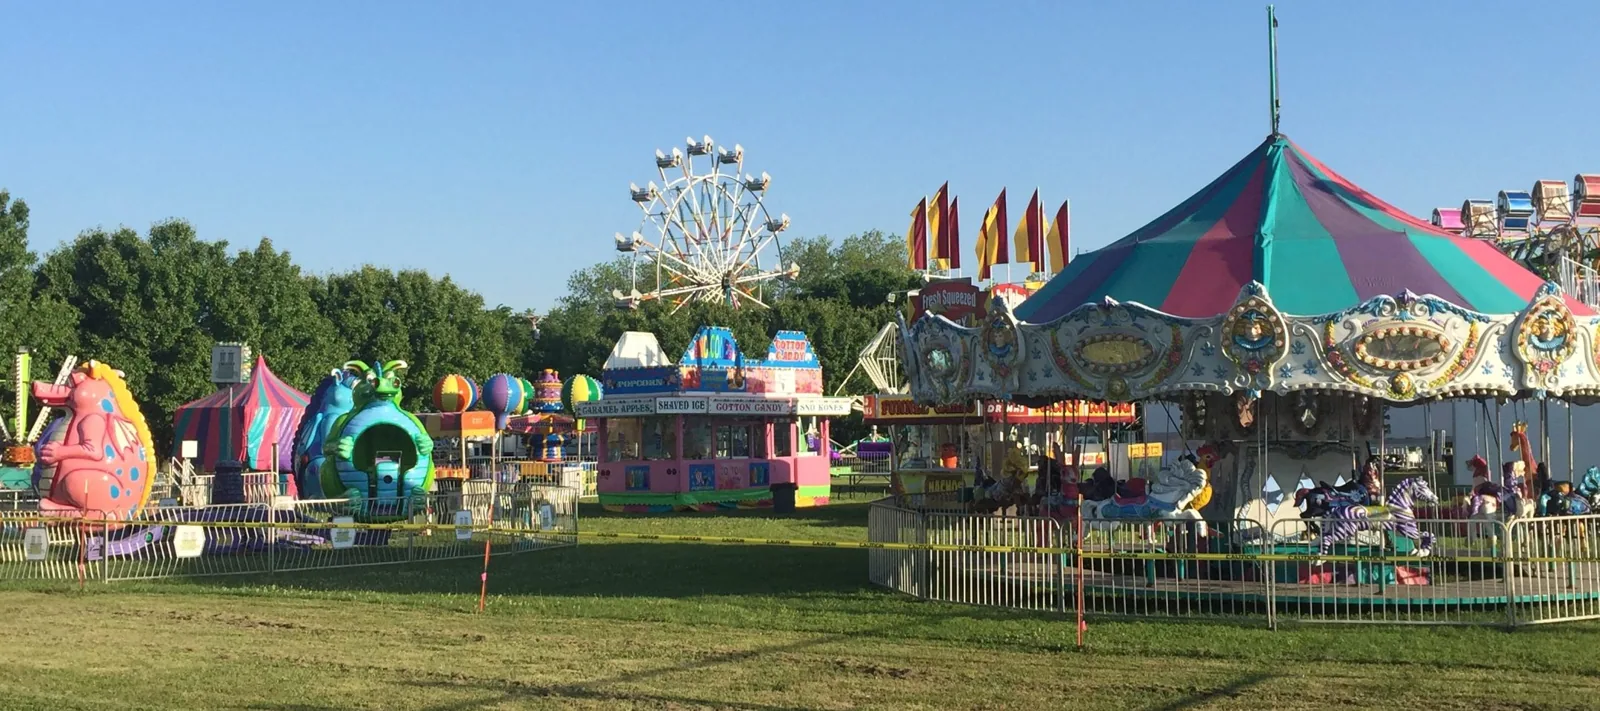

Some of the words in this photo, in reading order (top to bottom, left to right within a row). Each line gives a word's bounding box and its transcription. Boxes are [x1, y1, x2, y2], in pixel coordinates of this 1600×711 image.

[922, 291, 942, 310] Fresh
[942, 289, 977, 307] Squeezed
[775, 340, 806, 350] COTTON
[775, 350, 806, 361] CANDY
[617, 379, 663, 388] POPCORN
[582, 404, 619, 415] CARAMEL
[620, 402, 651, 413] APPLES
[658, 400, 690, 410] SHAVED
[692, 400, 706, 410] ICE
[716, 402, 752, 412] COTTON
[754, 402, 784, 412] CANDY
[800, 402, 816, 411] SNO
[818, 402, 844, 411] KONES
[987, 404, 1025, 413] DRNKS
